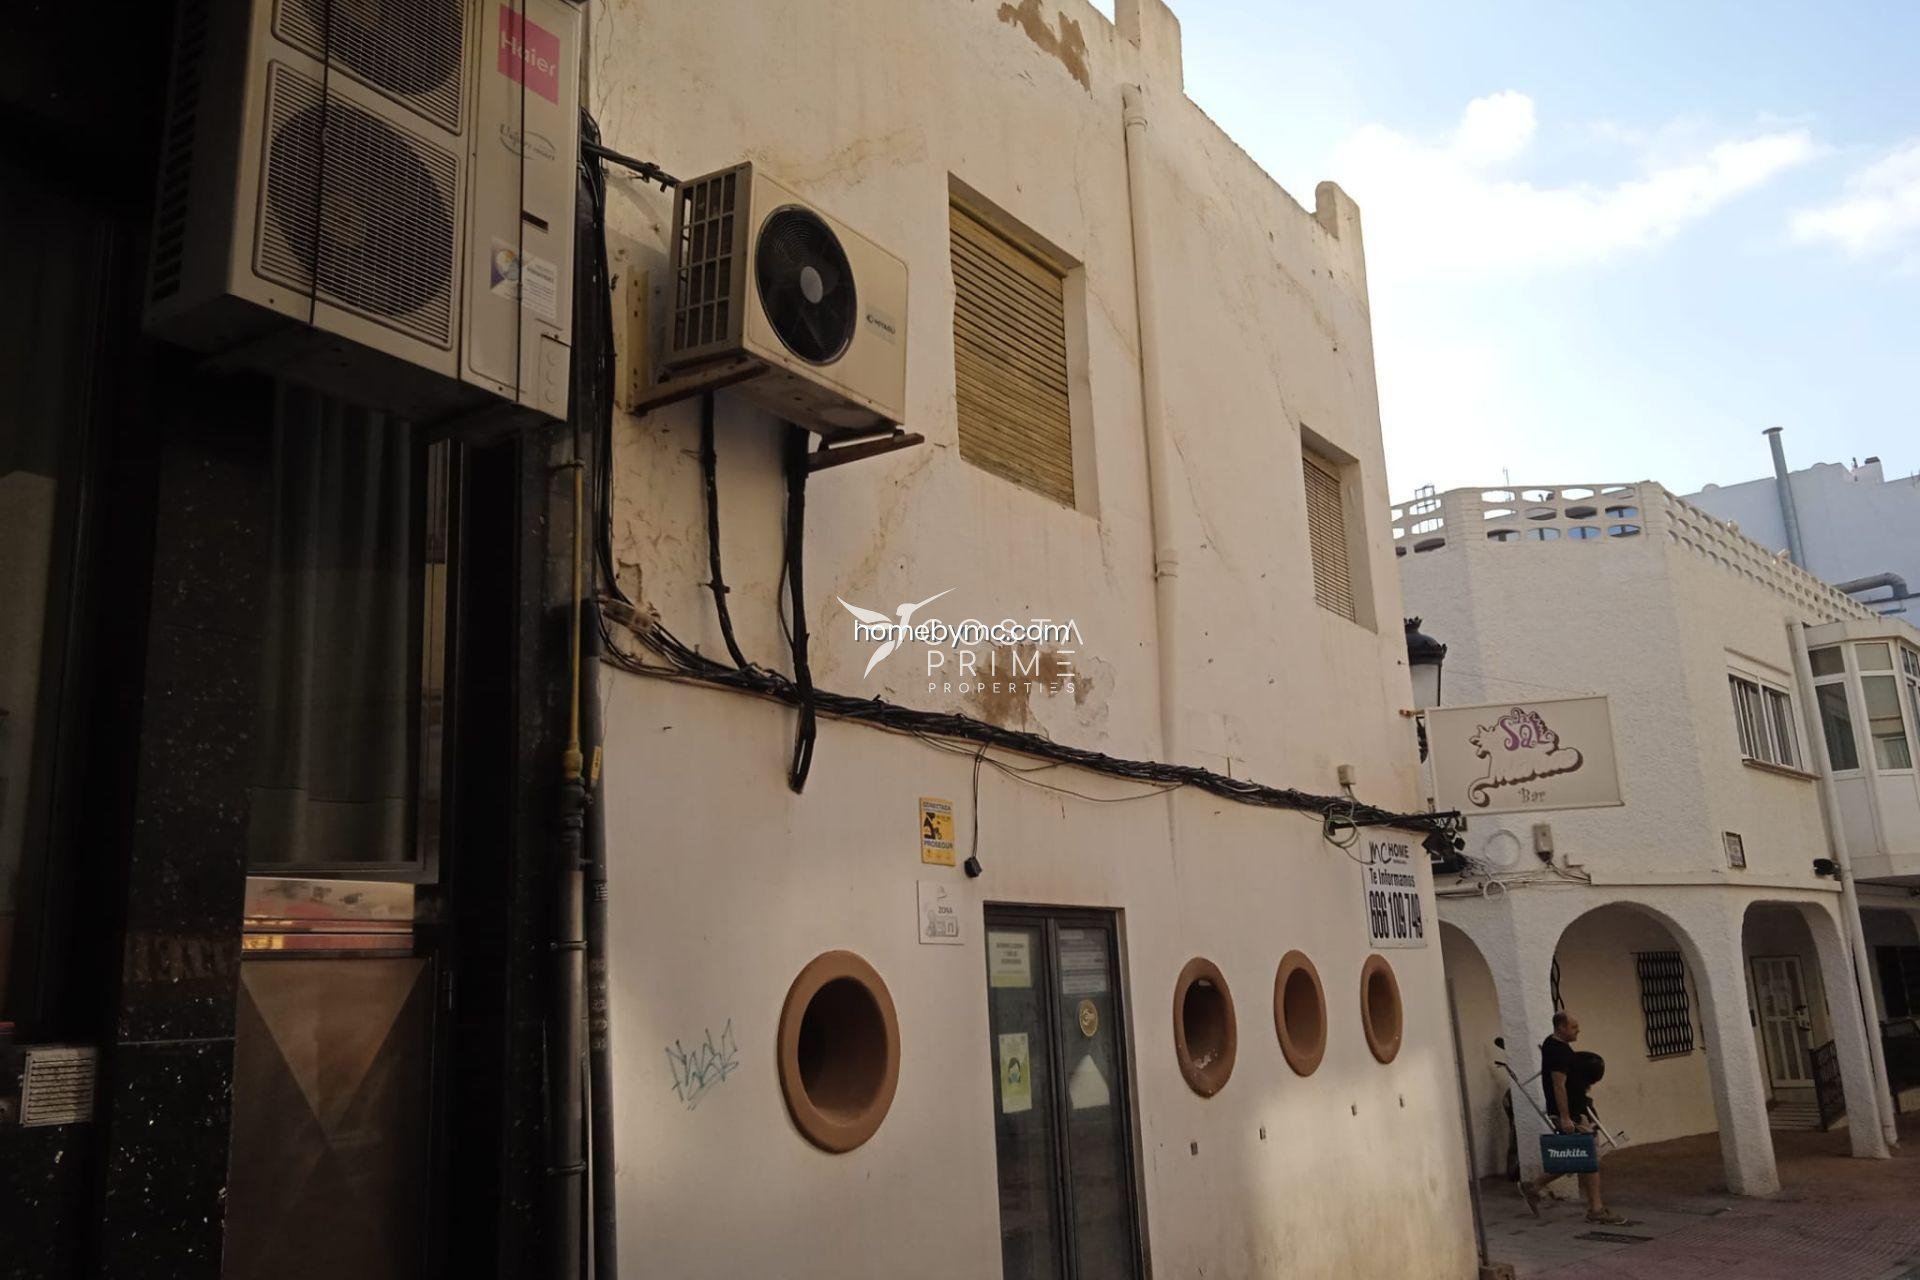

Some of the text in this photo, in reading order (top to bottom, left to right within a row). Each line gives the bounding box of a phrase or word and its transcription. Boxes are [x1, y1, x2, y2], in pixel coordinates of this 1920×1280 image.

[500, 31, 556, 77] Haier
[1518, 787, 1546, 803] Bar
[1388, 843, 1409, 858] HOME
[1369, 868, 1416, 887] Te Informamos
[1369, 890, 1389, 939] 666
